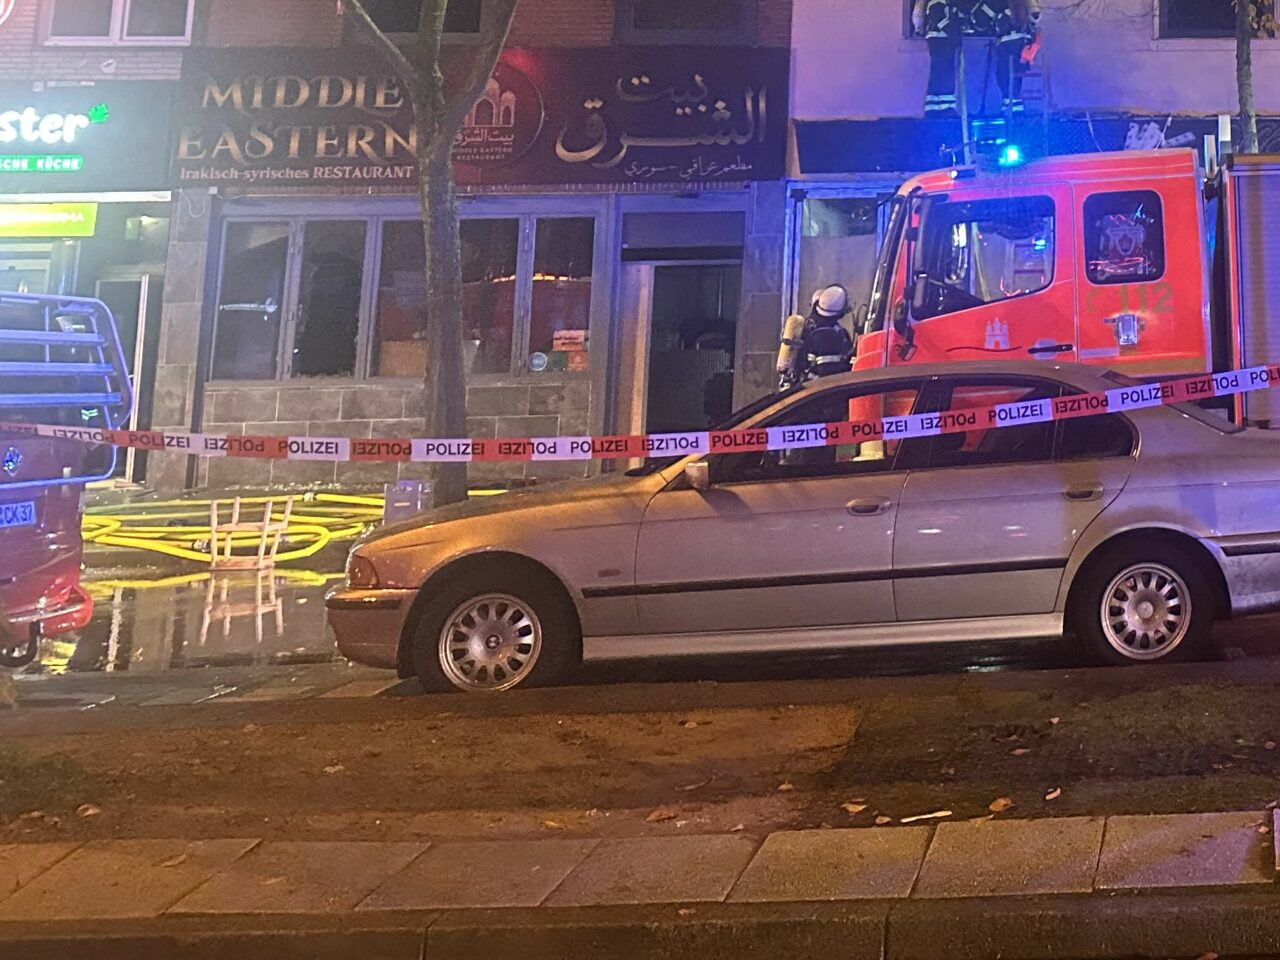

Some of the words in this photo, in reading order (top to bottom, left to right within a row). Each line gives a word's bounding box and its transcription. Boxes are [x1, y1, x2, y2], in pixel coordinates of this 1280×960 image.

[201, 75, 404, 117] MIDDLE
[176, 120, 418, 165] EASTERN
[0, 158, 29, 170] CHE
[180, 166, 310, 182] Irakisch-syrisches
[312, 165, 414, 179] RESTAURANT
[1116, 282, 1174, 314] 112
[129, 434, 191, 449] POLIZEI
[204, 437, 265, 452] POLIZEI
[278, 441, 339, 455] POLIZEI
[352, 441, 412, 456] POLIZEI
[426, 443, 485, 456] POLIZEI
[499, 442, 557, 455] POLIZEI
[570, 439, 628, 454] POLIZEI
[642, 436, 699, 451] POLIZEI
[712, 431, 769, 448] POLIZEI
[782, 426, 839, 443] POLIZEI
[852, 419, 908, 438] POLIZEI
[920, 412, 976, 431] POLIZEI
[988, 403, 1043, 423] POLIZEI
[1055, 395, 1109, 413] POLIZEI
[1121, 383, 1175, 405] POLIZEI
[1186, 374, 1239, 395] POLIZEI
